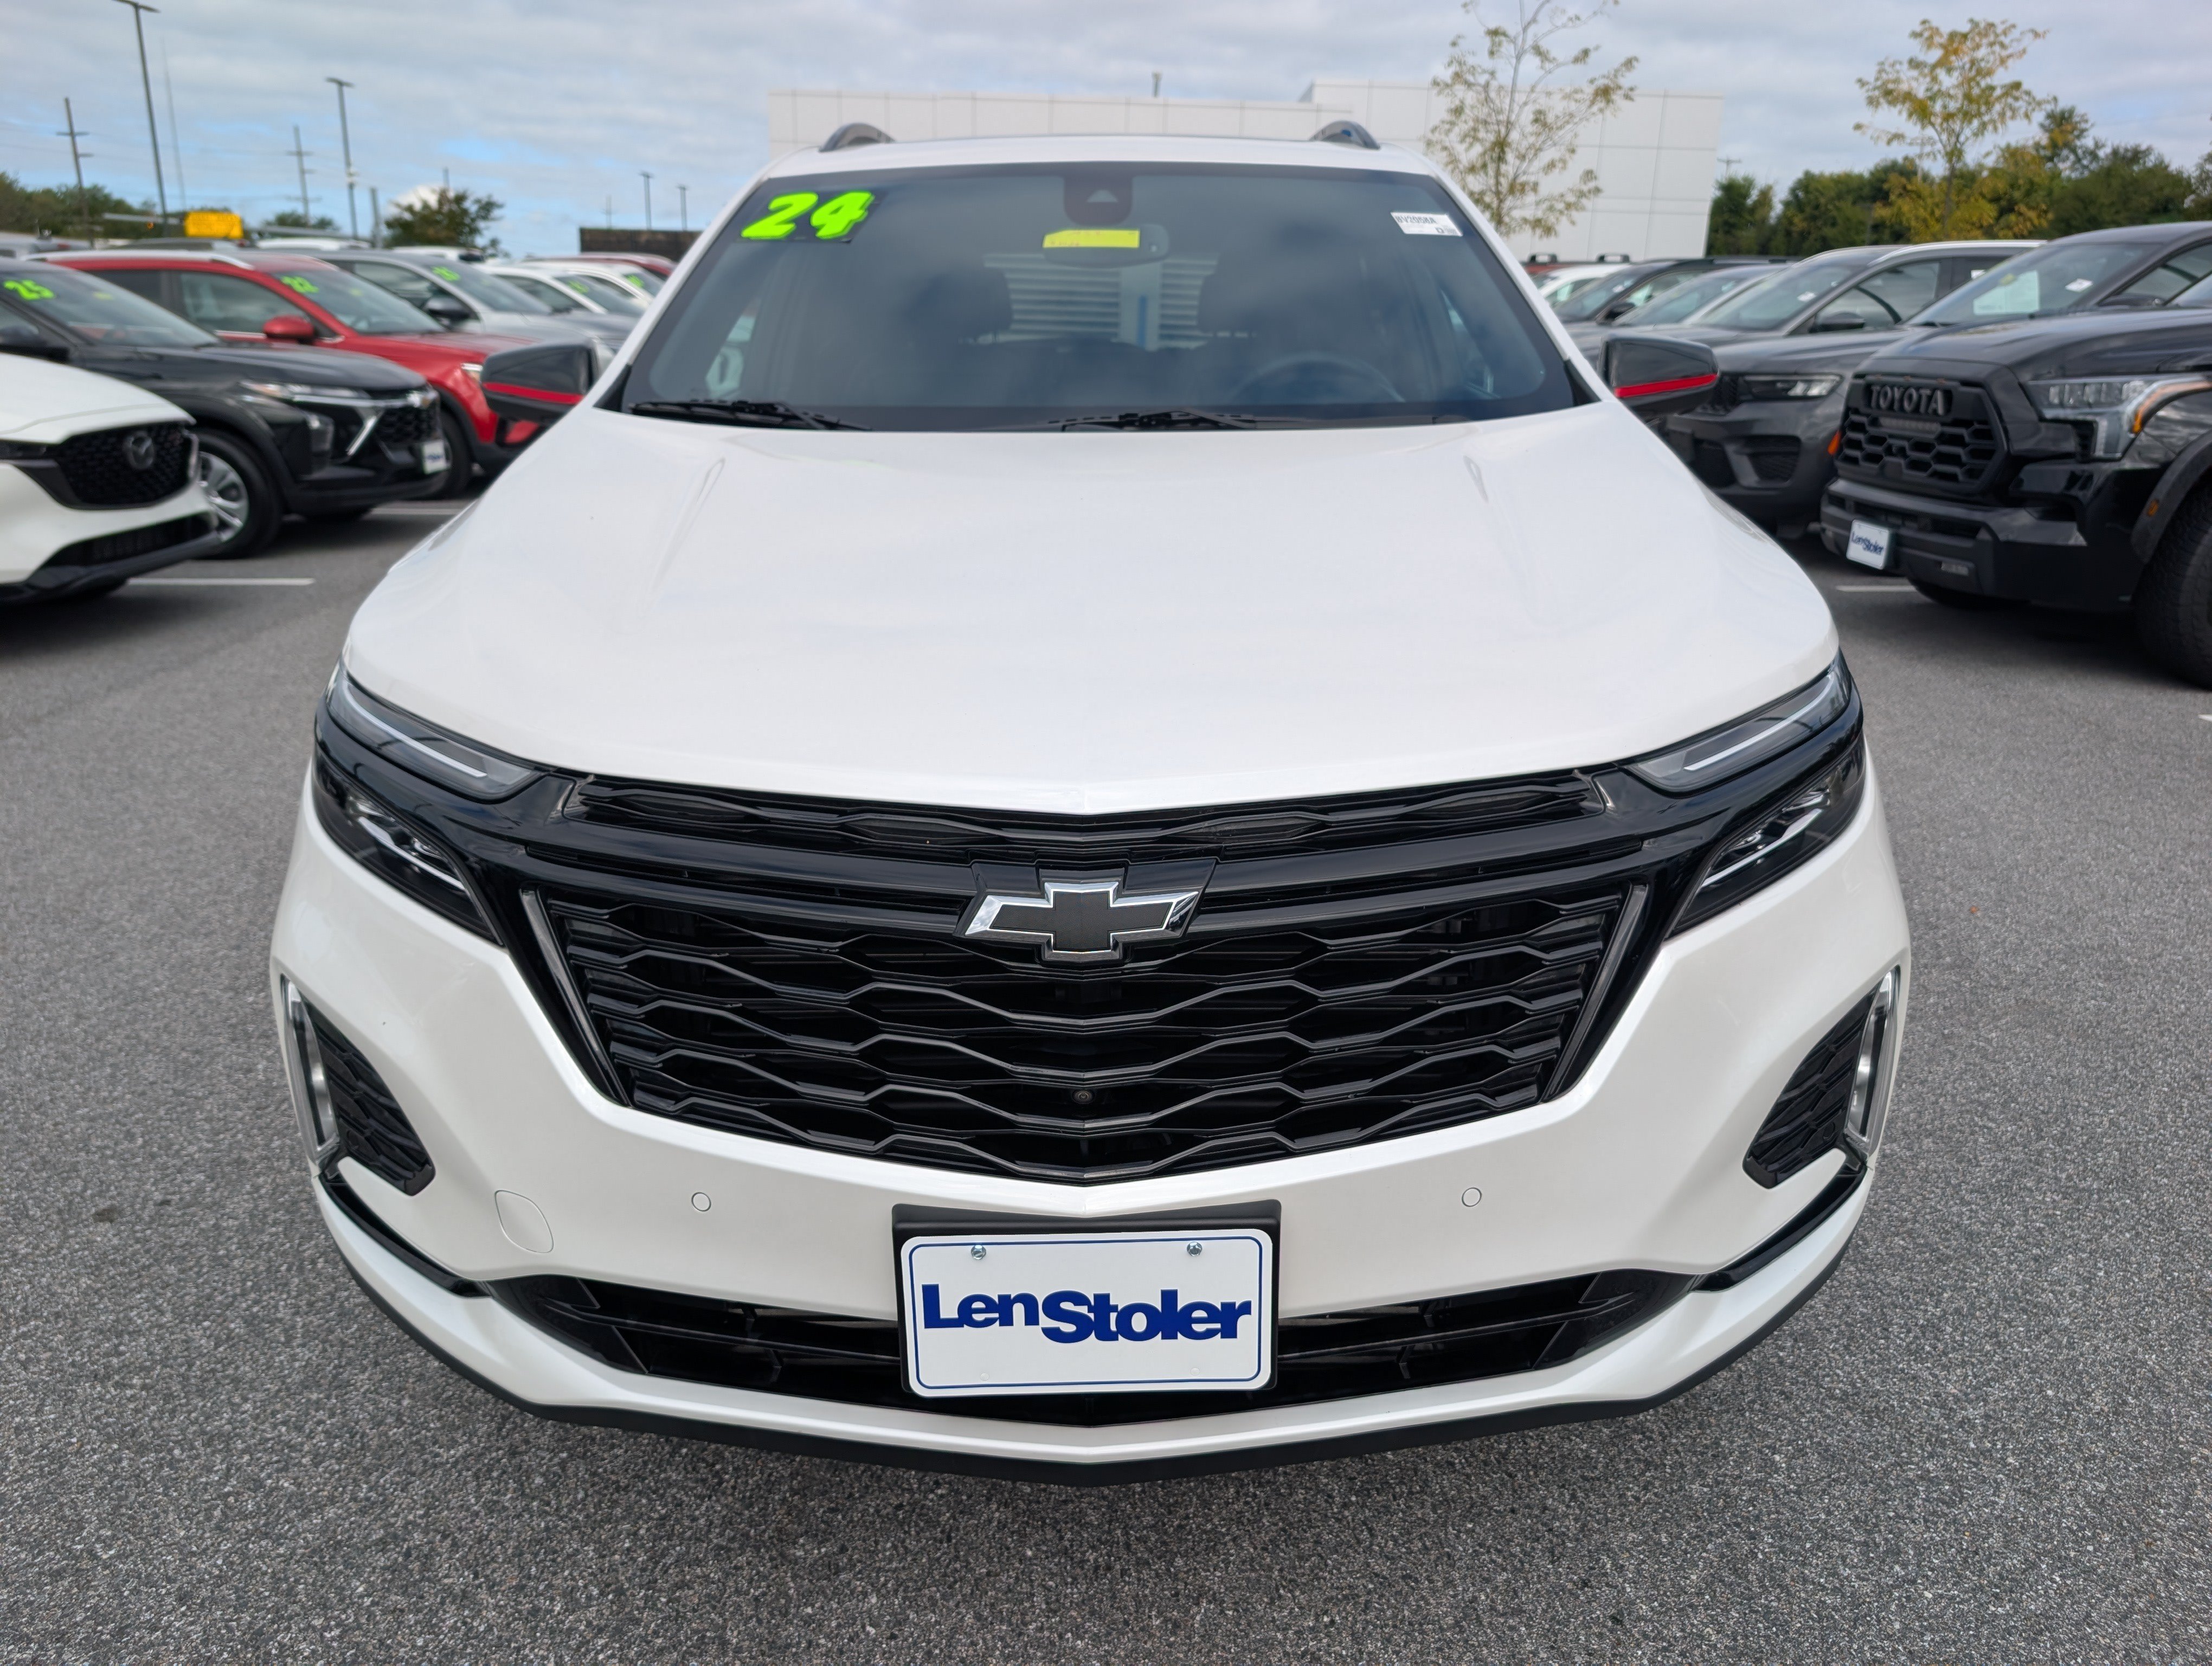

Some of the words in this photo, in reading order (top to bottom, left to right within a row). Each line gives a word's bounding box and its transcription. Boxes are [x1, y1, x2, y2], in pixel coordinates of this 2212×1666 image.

[741, 192, 875, 239] 24
[4, 279, 54, 300] 25
[1871, 385, 1944, 416] TOYOTA
[922, 1283, 1252, 1343] LenStoler
